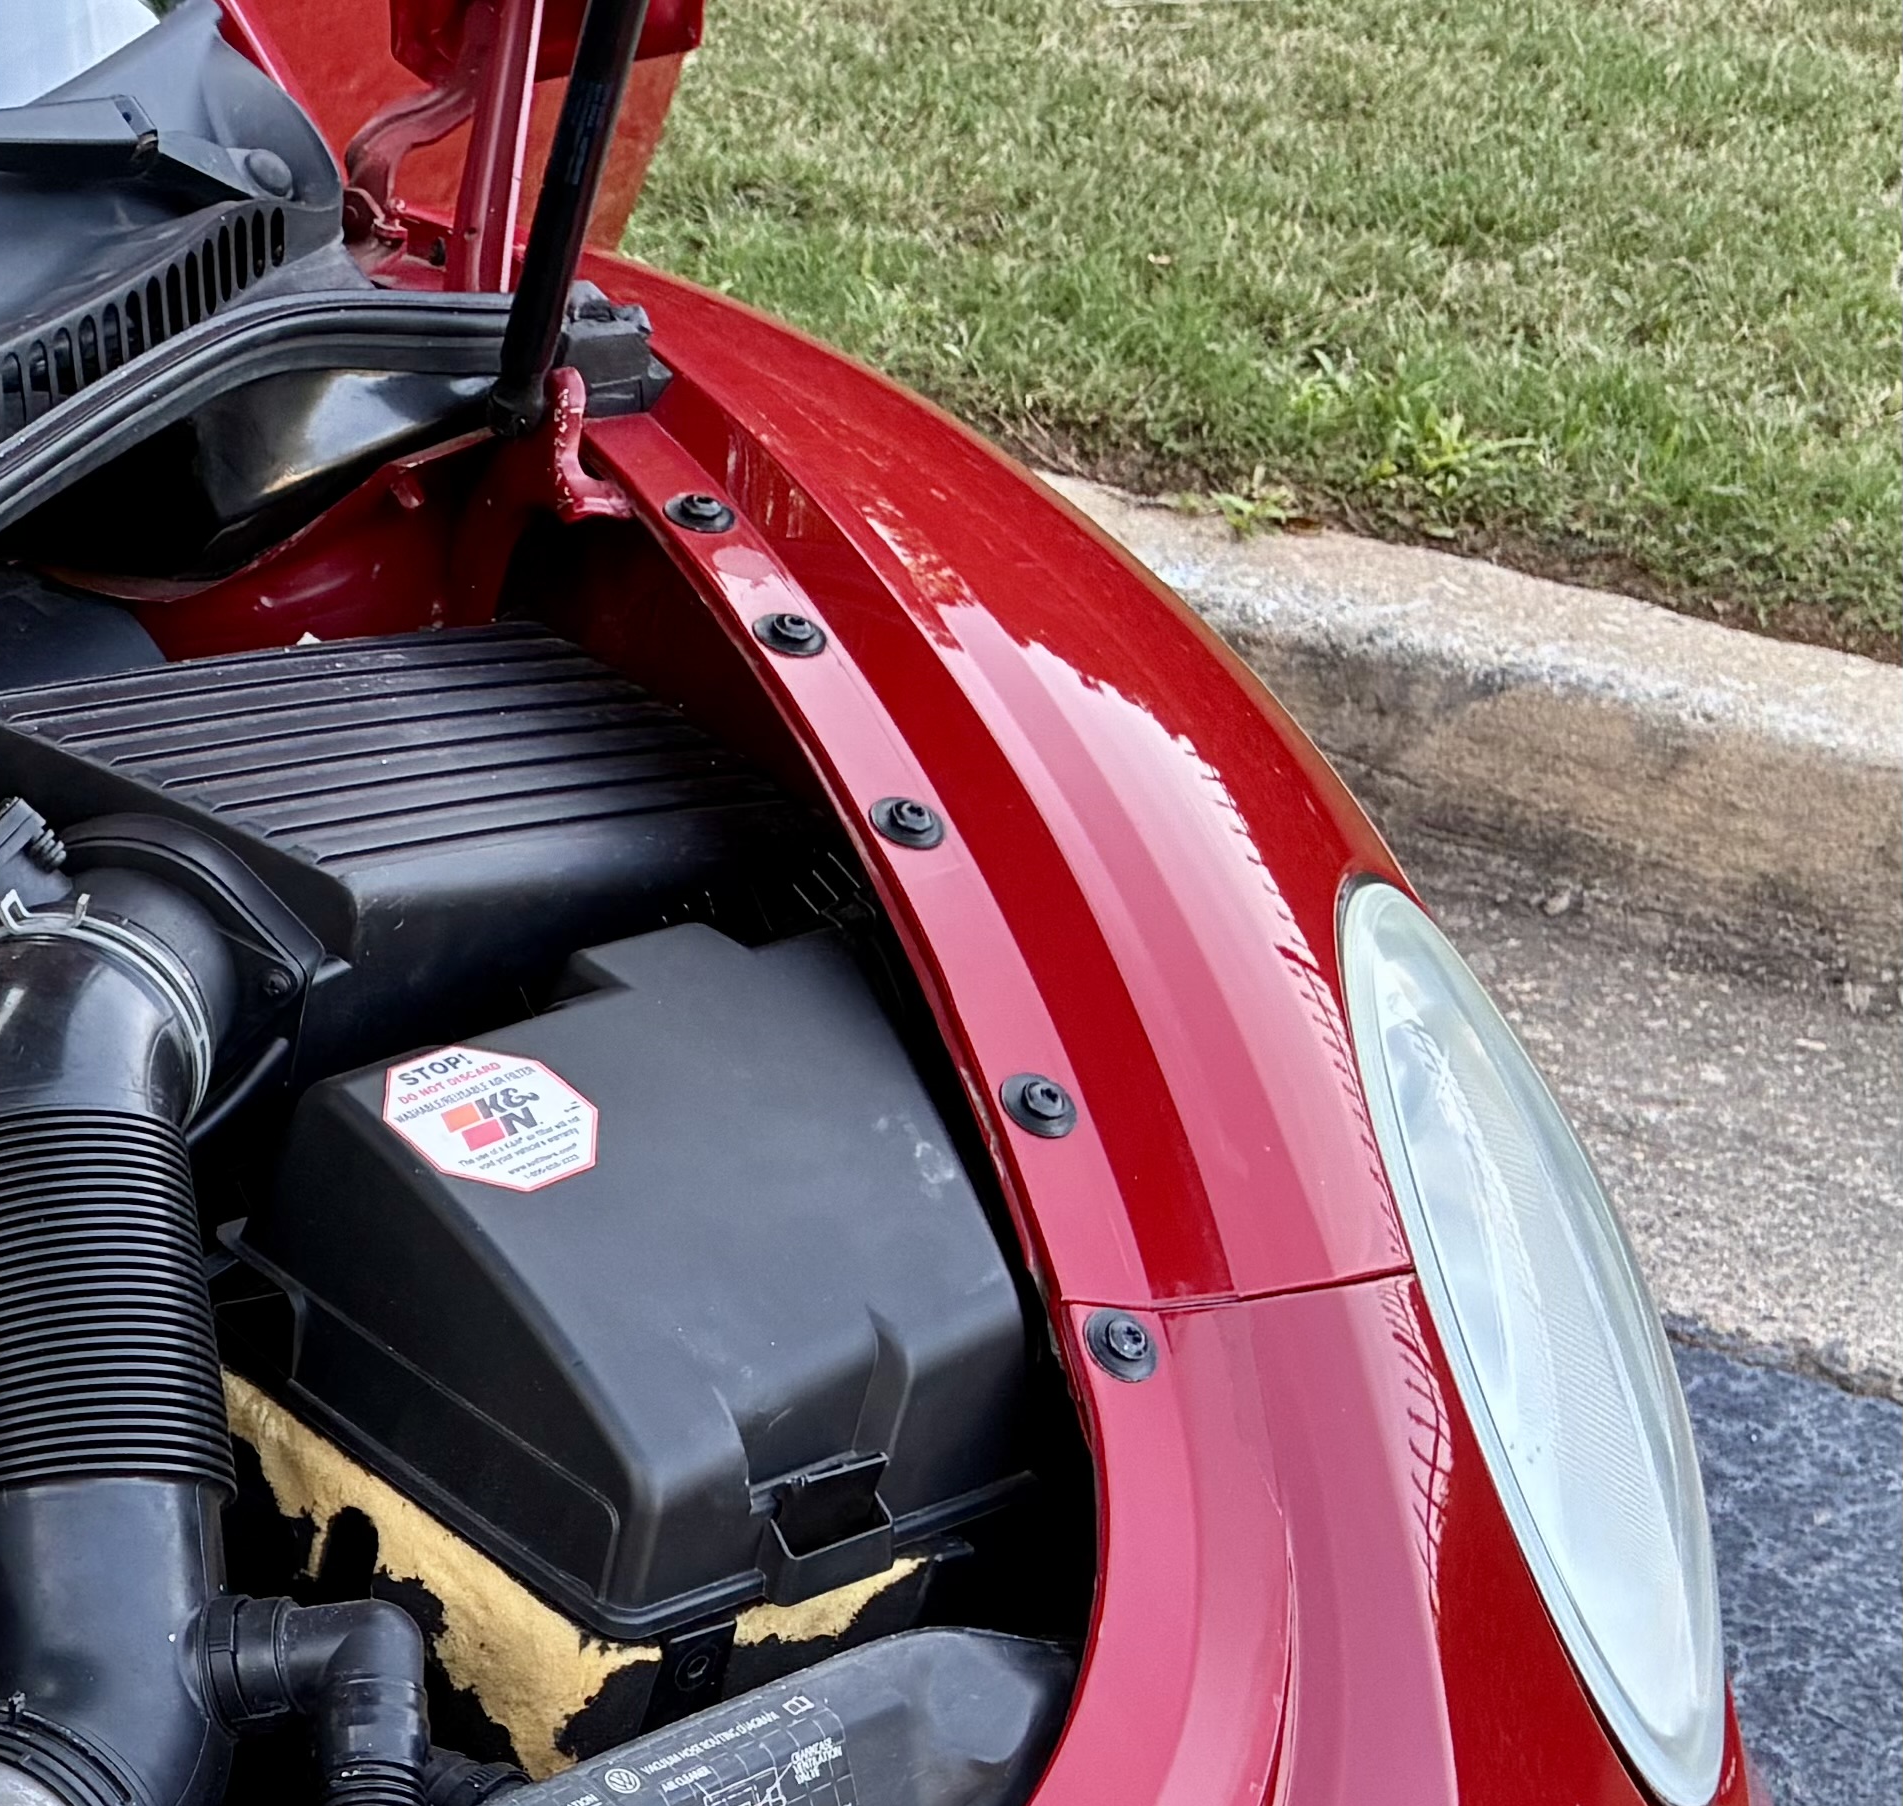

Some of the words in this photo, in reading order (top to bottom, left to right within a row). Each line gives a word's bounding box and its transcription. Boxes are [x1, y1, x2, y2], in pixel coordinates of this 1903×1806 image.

[398, 1053, 474, 1086] STOP!
[398, 1093, 419, 1105] DO
[418, 1081, 446, 1097] NOT
[446, 1062, 502, 1086] DISCARD
